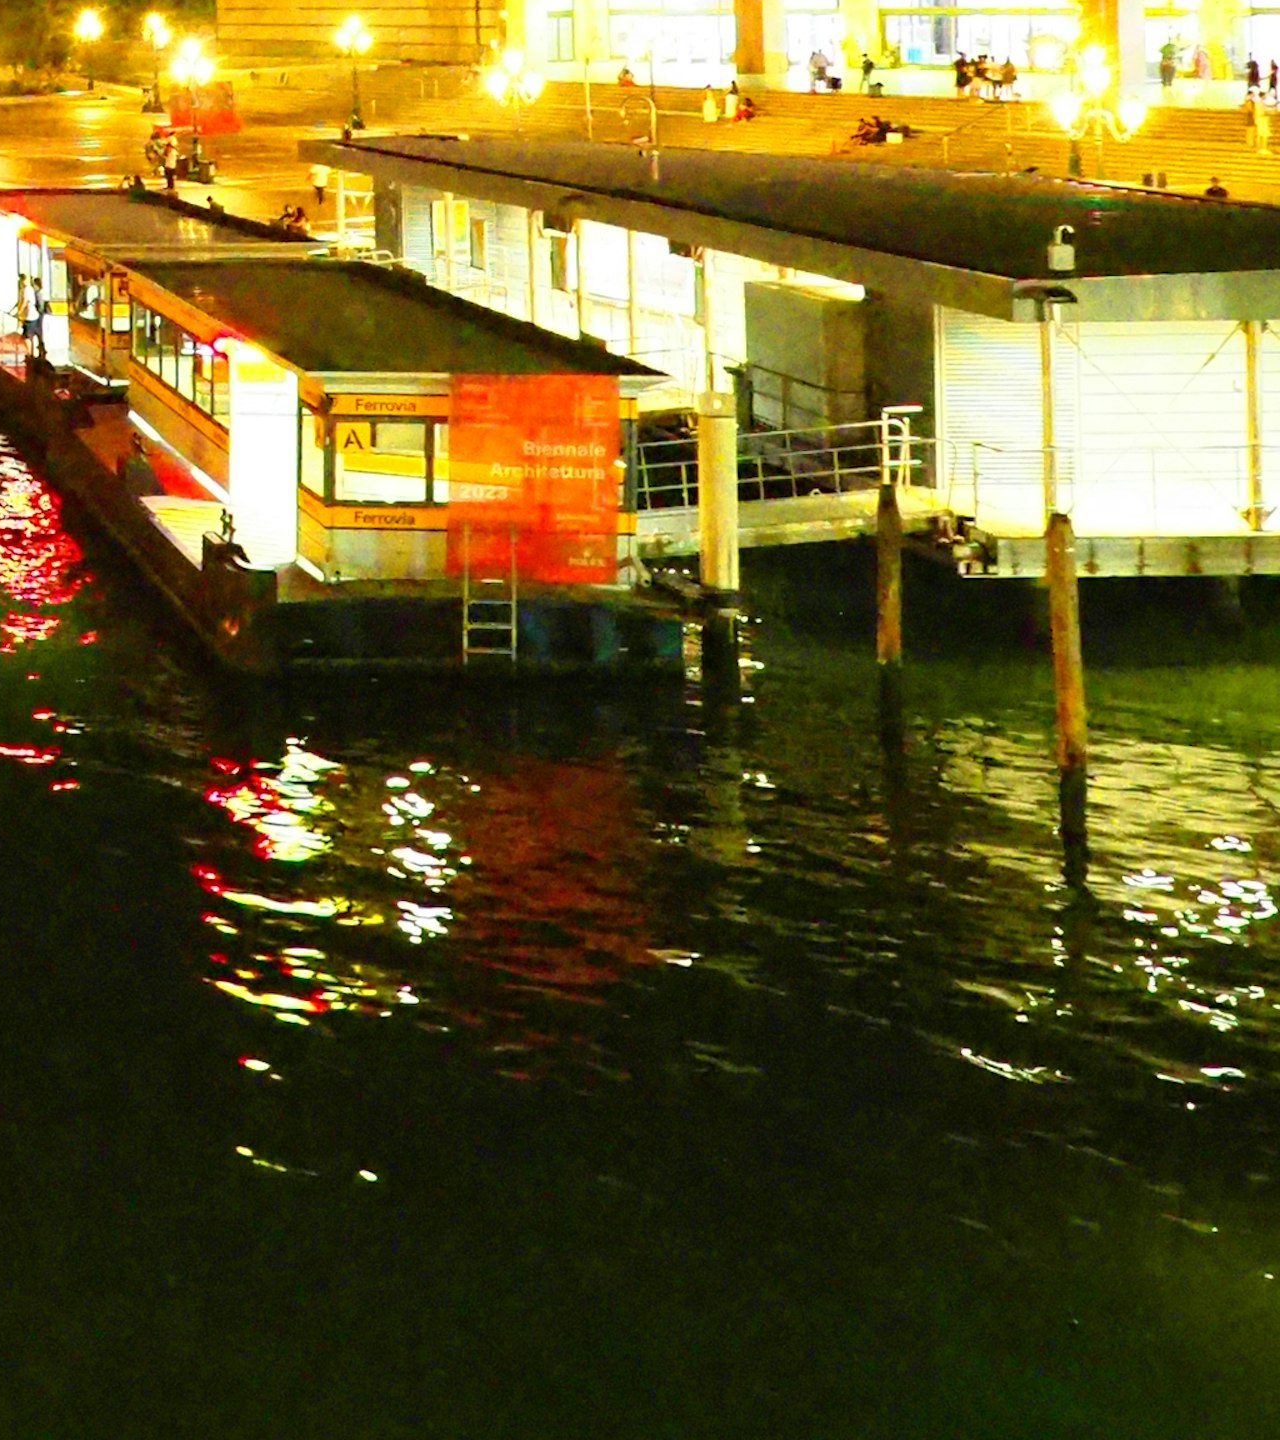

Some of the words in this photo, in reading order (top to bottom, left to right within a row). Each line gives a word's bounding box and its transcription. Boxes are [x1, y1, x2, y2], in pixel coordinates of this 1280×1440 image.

[355, 398, 416, 412] Ferrovia
[343, 429, 364, 449] A
[523, 441, 606, 457] Biennale
[490, 462, 606, 480] Architettura
[459, 484, 508, 500] 2023
[354, 511, 415, 525] Ferrovia
